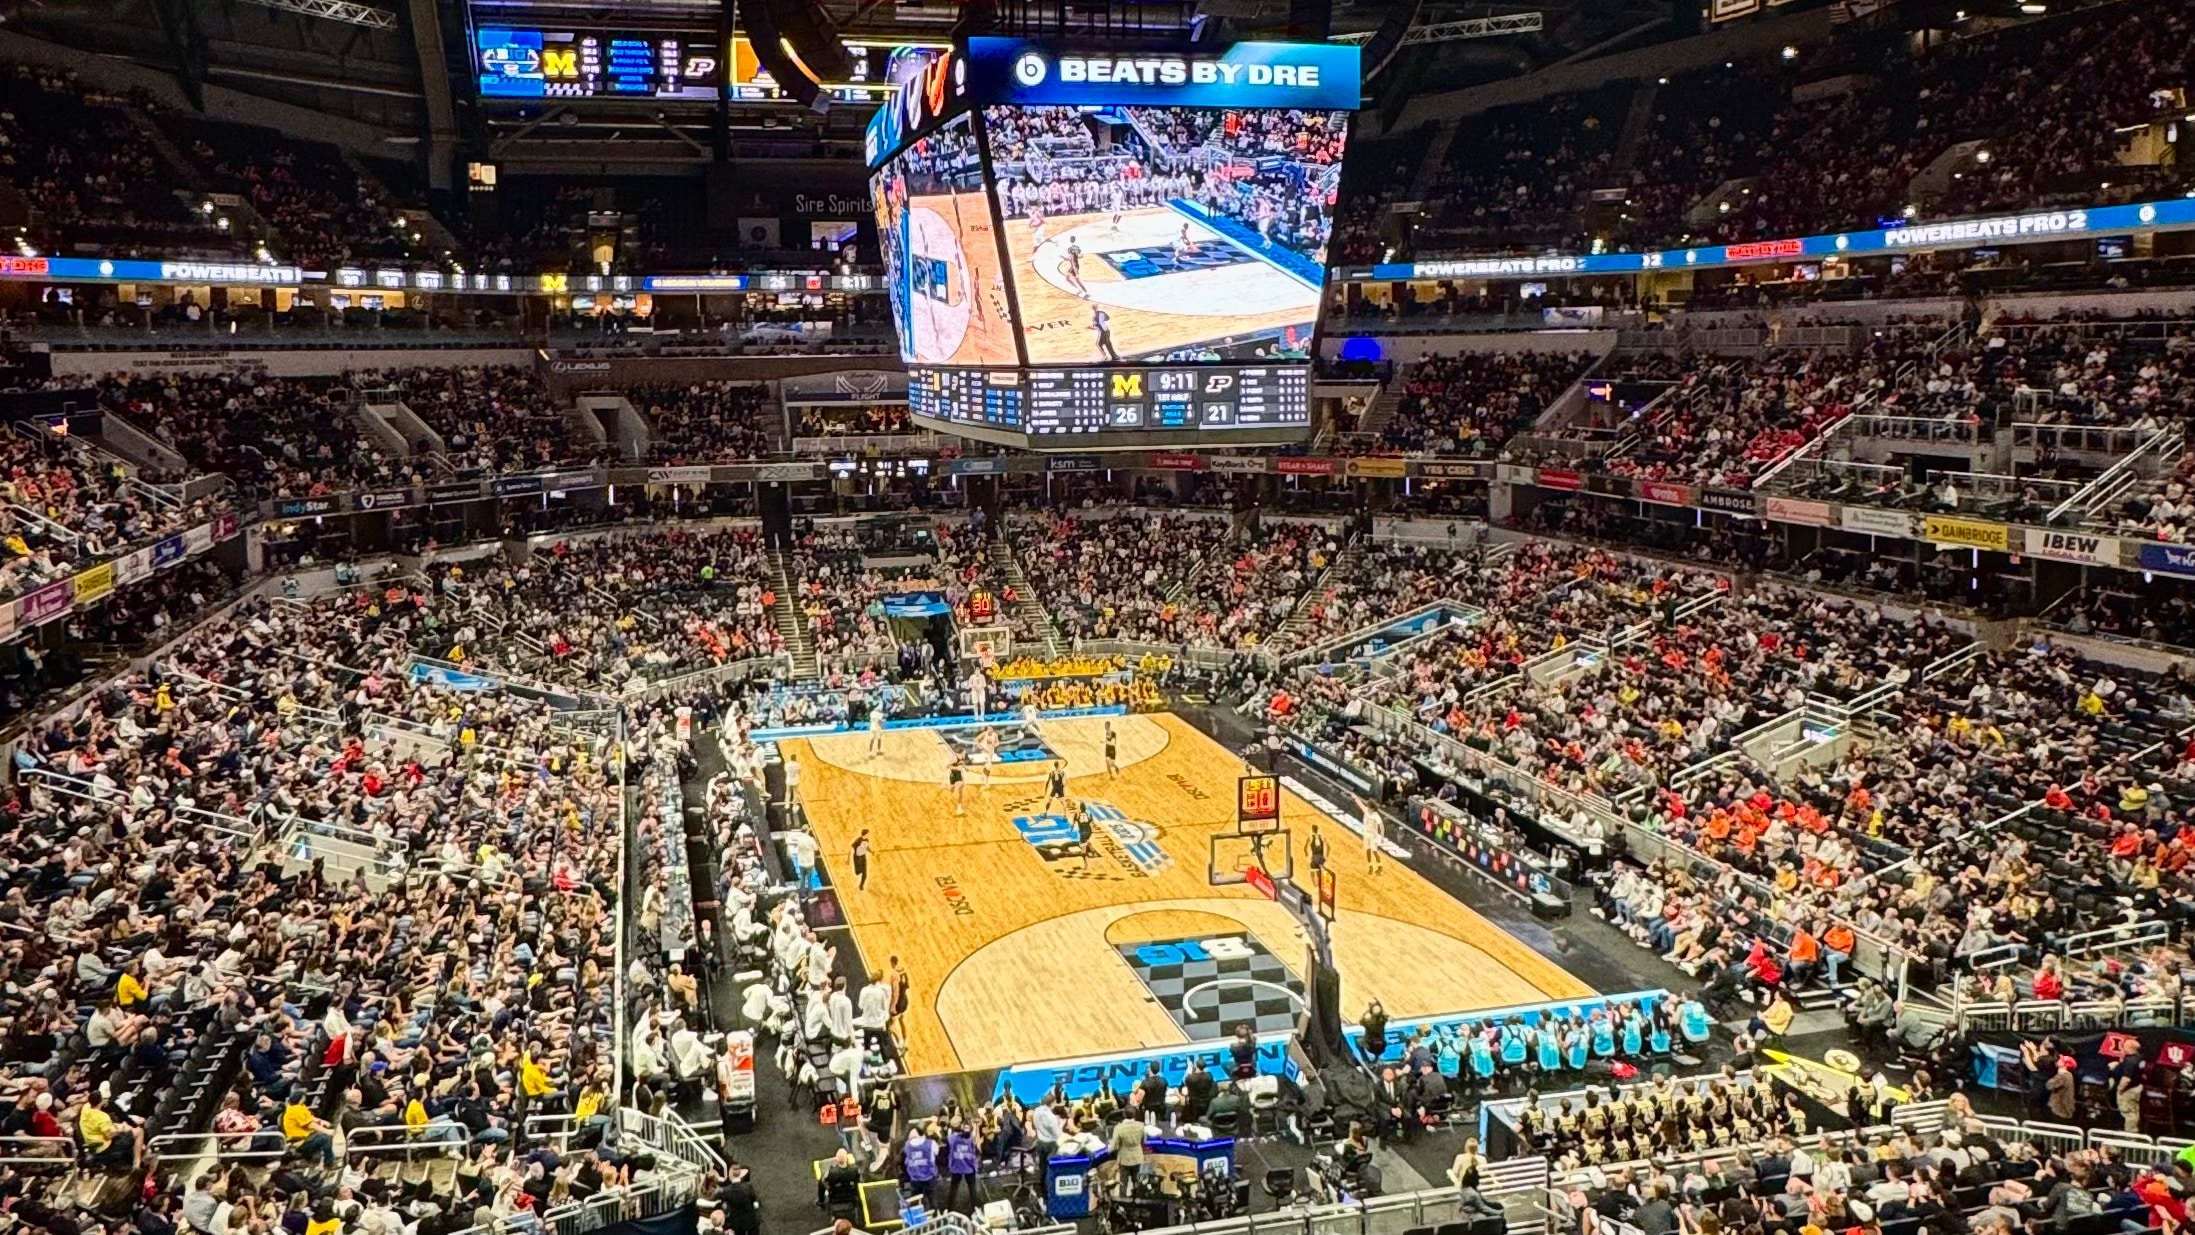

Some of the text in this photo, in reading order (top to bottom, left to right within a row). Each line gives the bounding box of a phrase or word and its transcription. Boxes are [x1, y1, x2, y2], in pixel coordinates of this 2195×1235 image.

[543, 50, 577, 76] M
[1060, 58, 1320, 87] BEATS BY DRE
[796, 194, 874, 216] Sire Spirits
[1885, 212, 2088, 246] POWERBEATS PRO 2
[161, 263, 293, 283] POWERBEATS
[1413, 258, 1534, 278] POWERBEATS
[1536, 256, 1575, 272] PRO
[567, 362, 610, 370] LEXUS
[1112, 374, 1143, 397] M
[1160, 374, 1193, 390] 9:11
[1116, 408, 1137, 423] 26
[1208, 406, 1227, 421] 21
[1050, 457, 1075, 469] ksm
[1212, 460, 1245, 469] KeyBank
[1422, 465, 1476, 476] YES 'CERS
[282, 501, 329, 513] IndyStar
[1703, 494, 1753, 510] AMBROSE
[1941, 523, 2004, 545] GAINBRIDGE
[2043, 533, 2100, 554] IBEW
